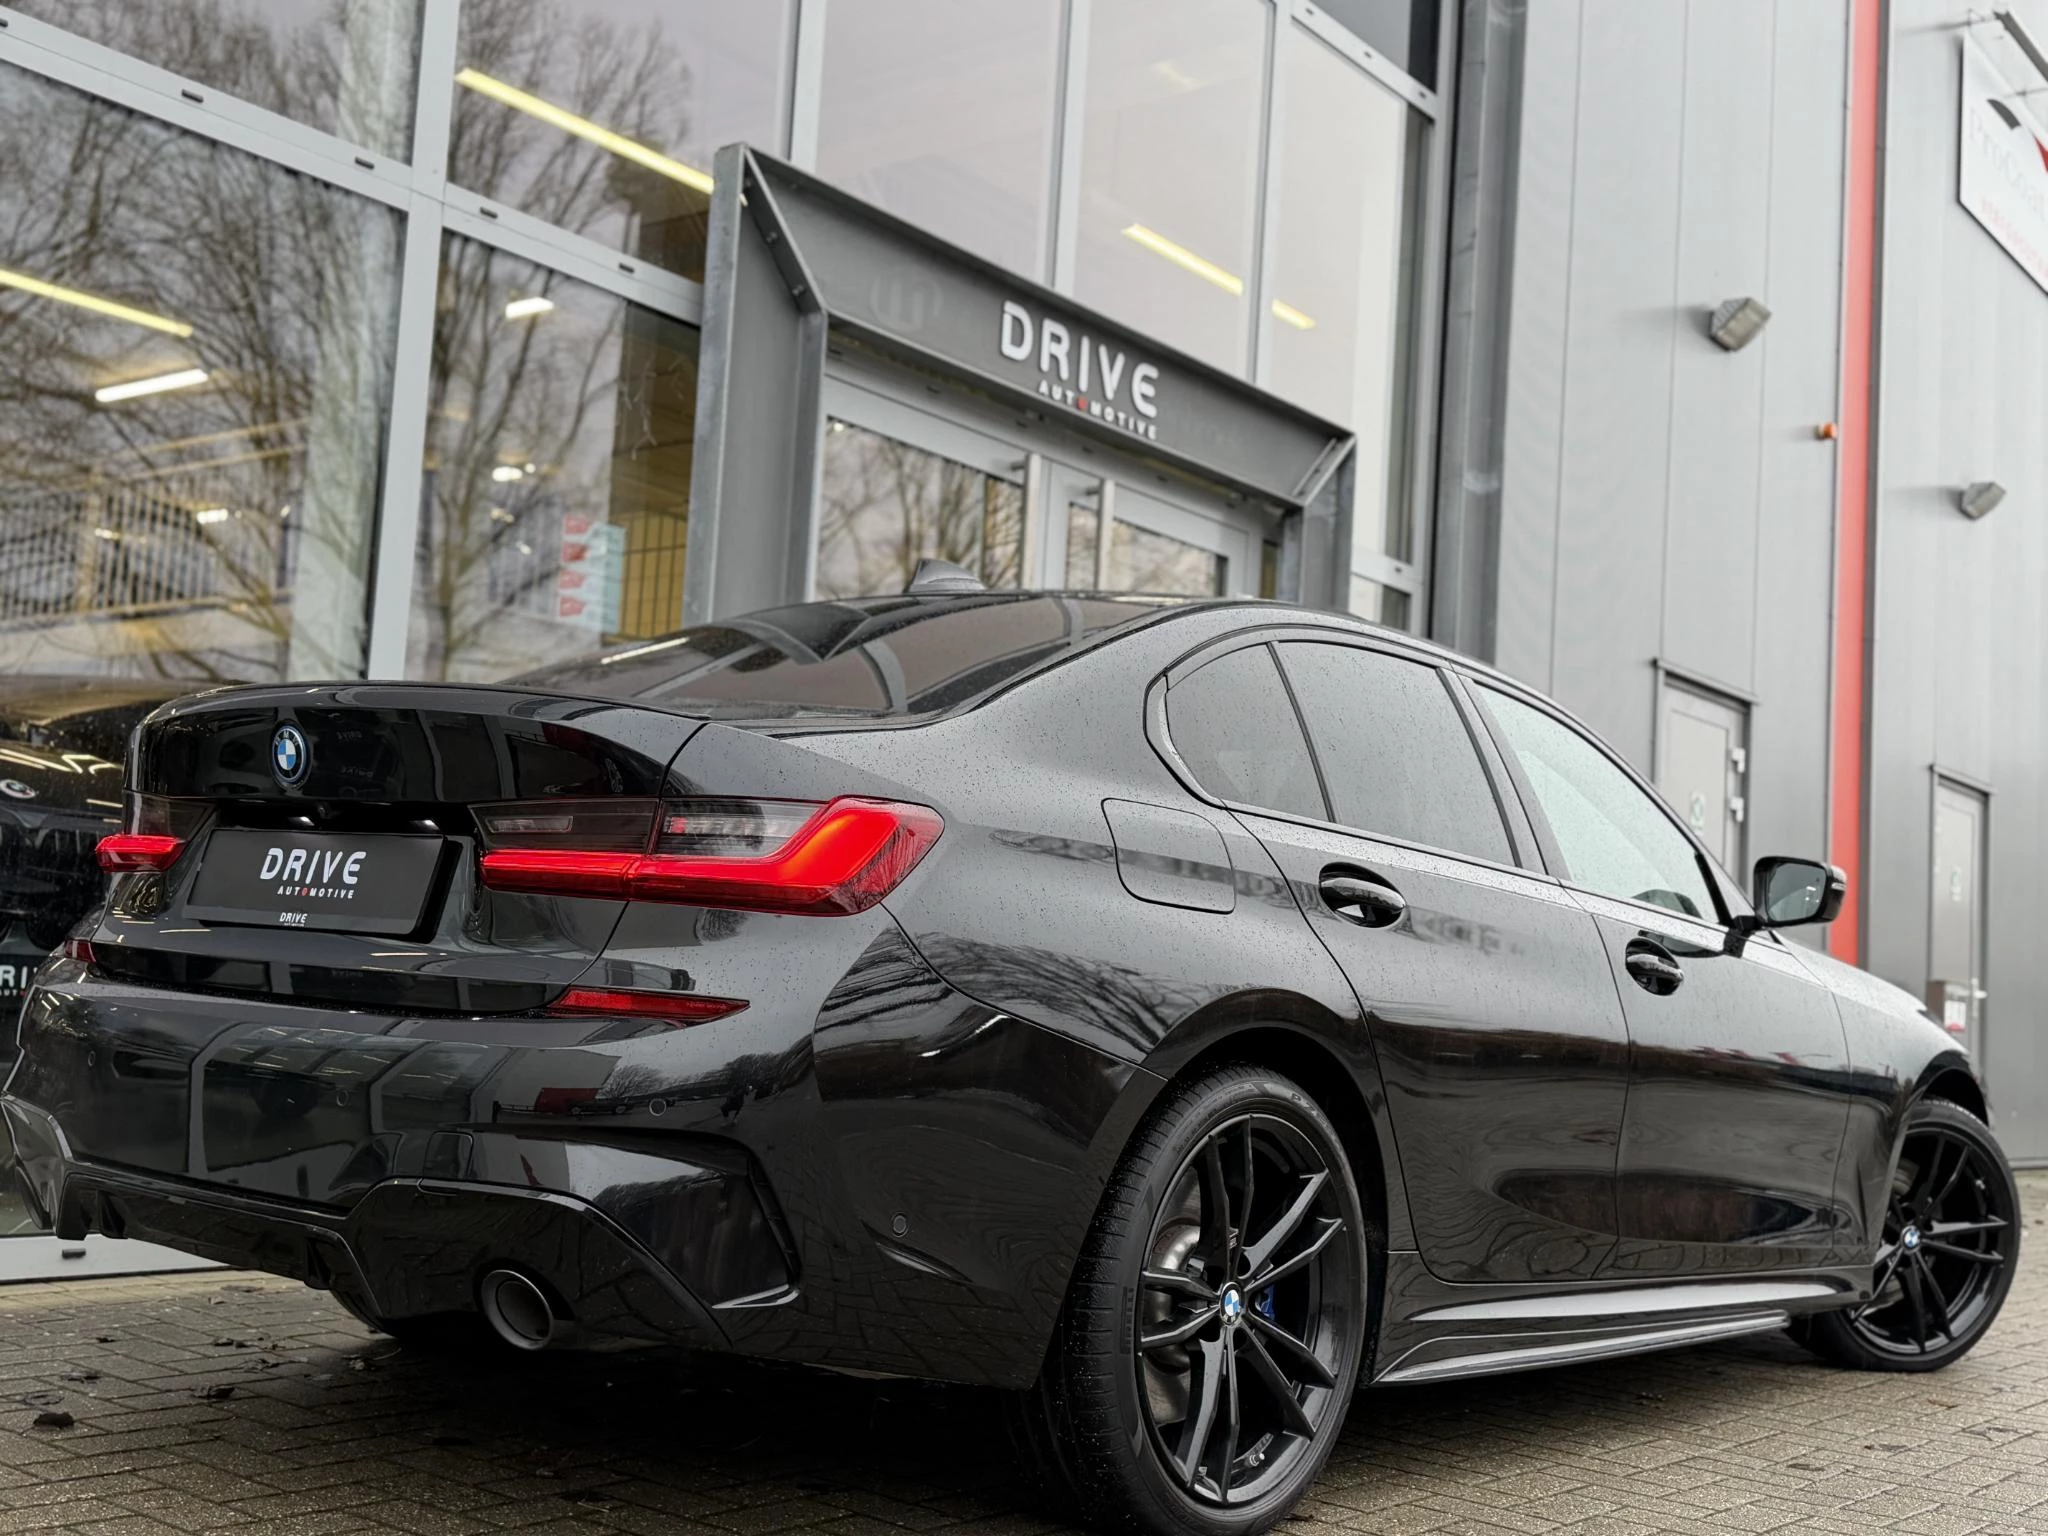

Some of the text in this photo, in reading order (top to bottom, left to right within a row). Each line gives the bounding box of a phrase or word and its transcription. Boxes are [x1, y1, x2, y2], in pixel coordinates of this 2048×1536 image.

[1001, 300, 1159, 418] DRIVE
[1038, 379, 1157, 440] AUTOMOTIVE
[260, 847, 367, 885] DRIVE
[277, 885, 355, 899] AUTOMOTIVE
[279, 911, 308, 924] DRIVE
